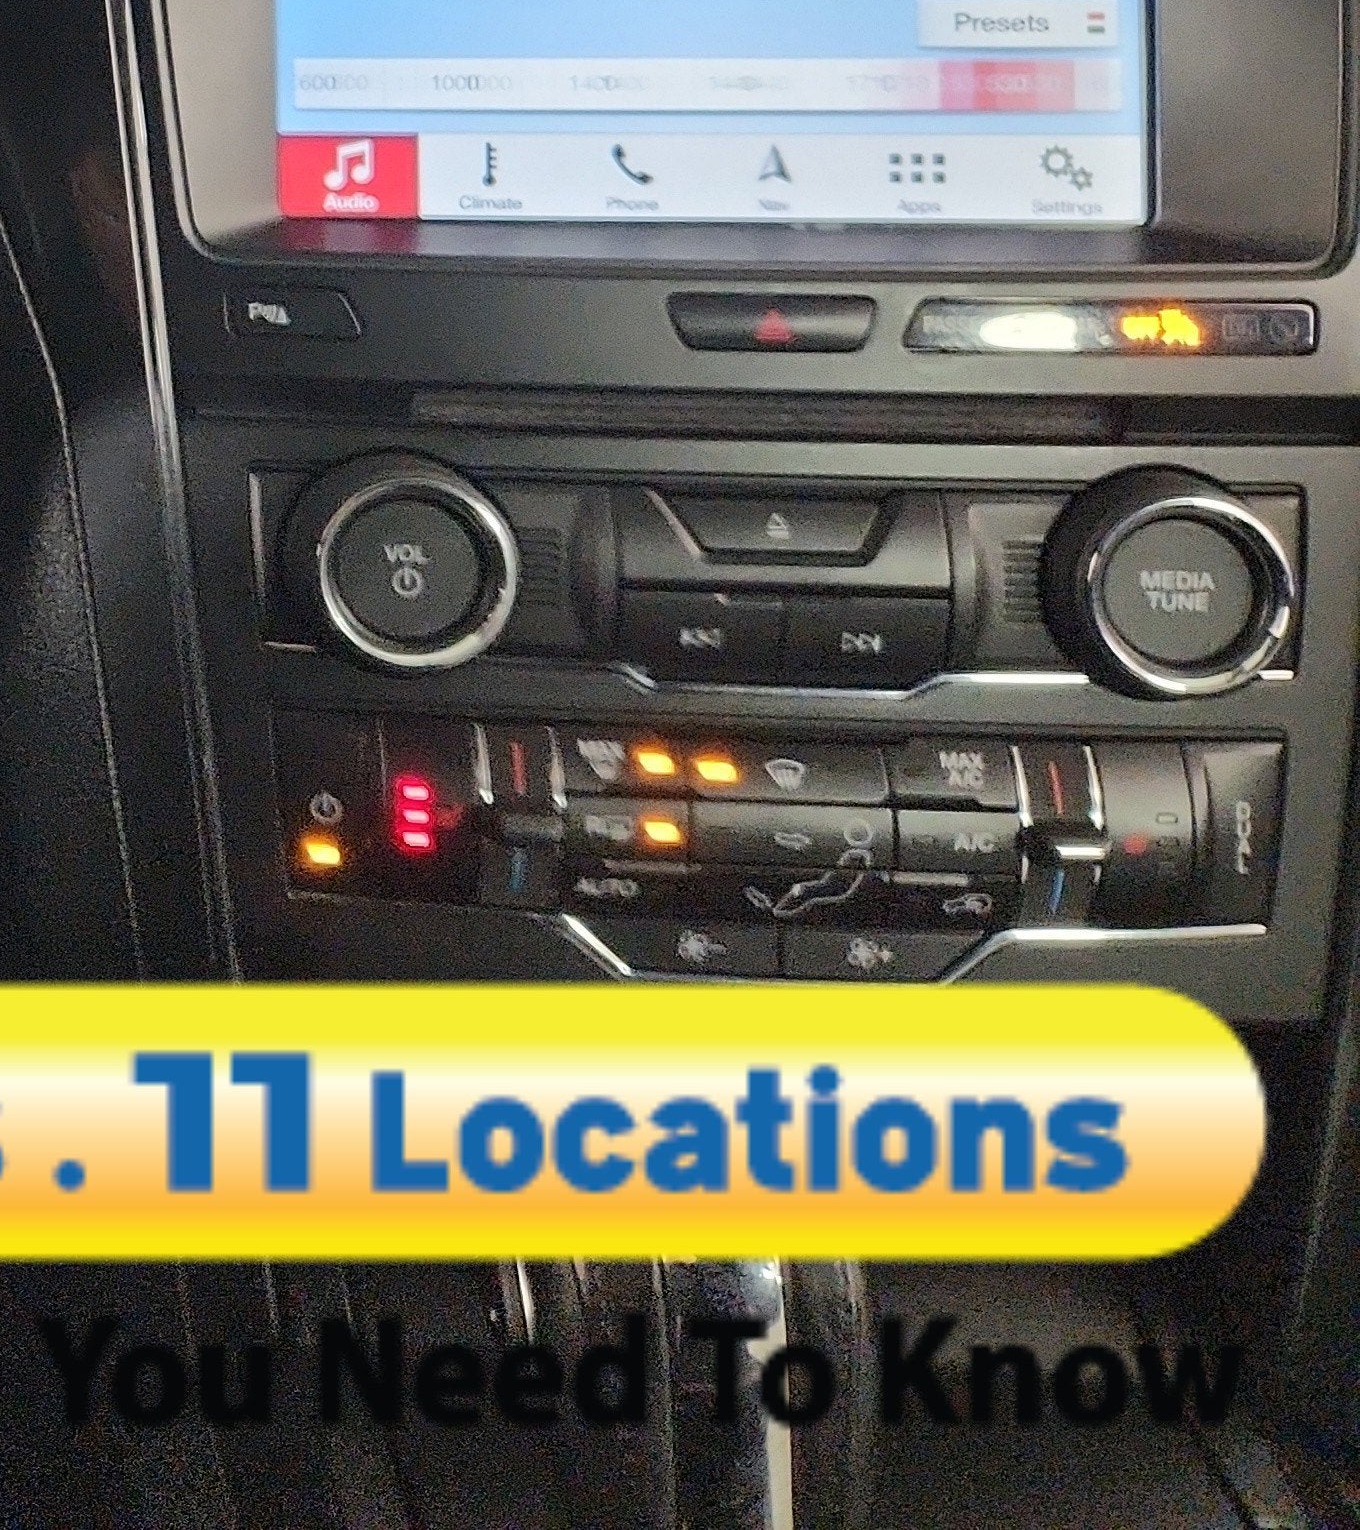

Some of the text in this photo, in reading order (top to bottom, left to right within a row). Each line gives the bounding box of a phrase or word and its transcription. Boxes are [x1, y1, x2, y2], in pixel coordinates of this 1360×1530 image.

[954, 12, 1050, 32] Presets
[323, 193, 378, 213] Audio
[459, 195, 523, 211] Climate
[606, 196, 659, 212] Phone
[897, 199, 942, 215] Apps
[1032, 199, 1103, 216] Settings
[383, 544, 429, 565] VOL
[1140, 570, 1215, 590] MEDIA
[1145, 590, 1209, 612] TUNE
